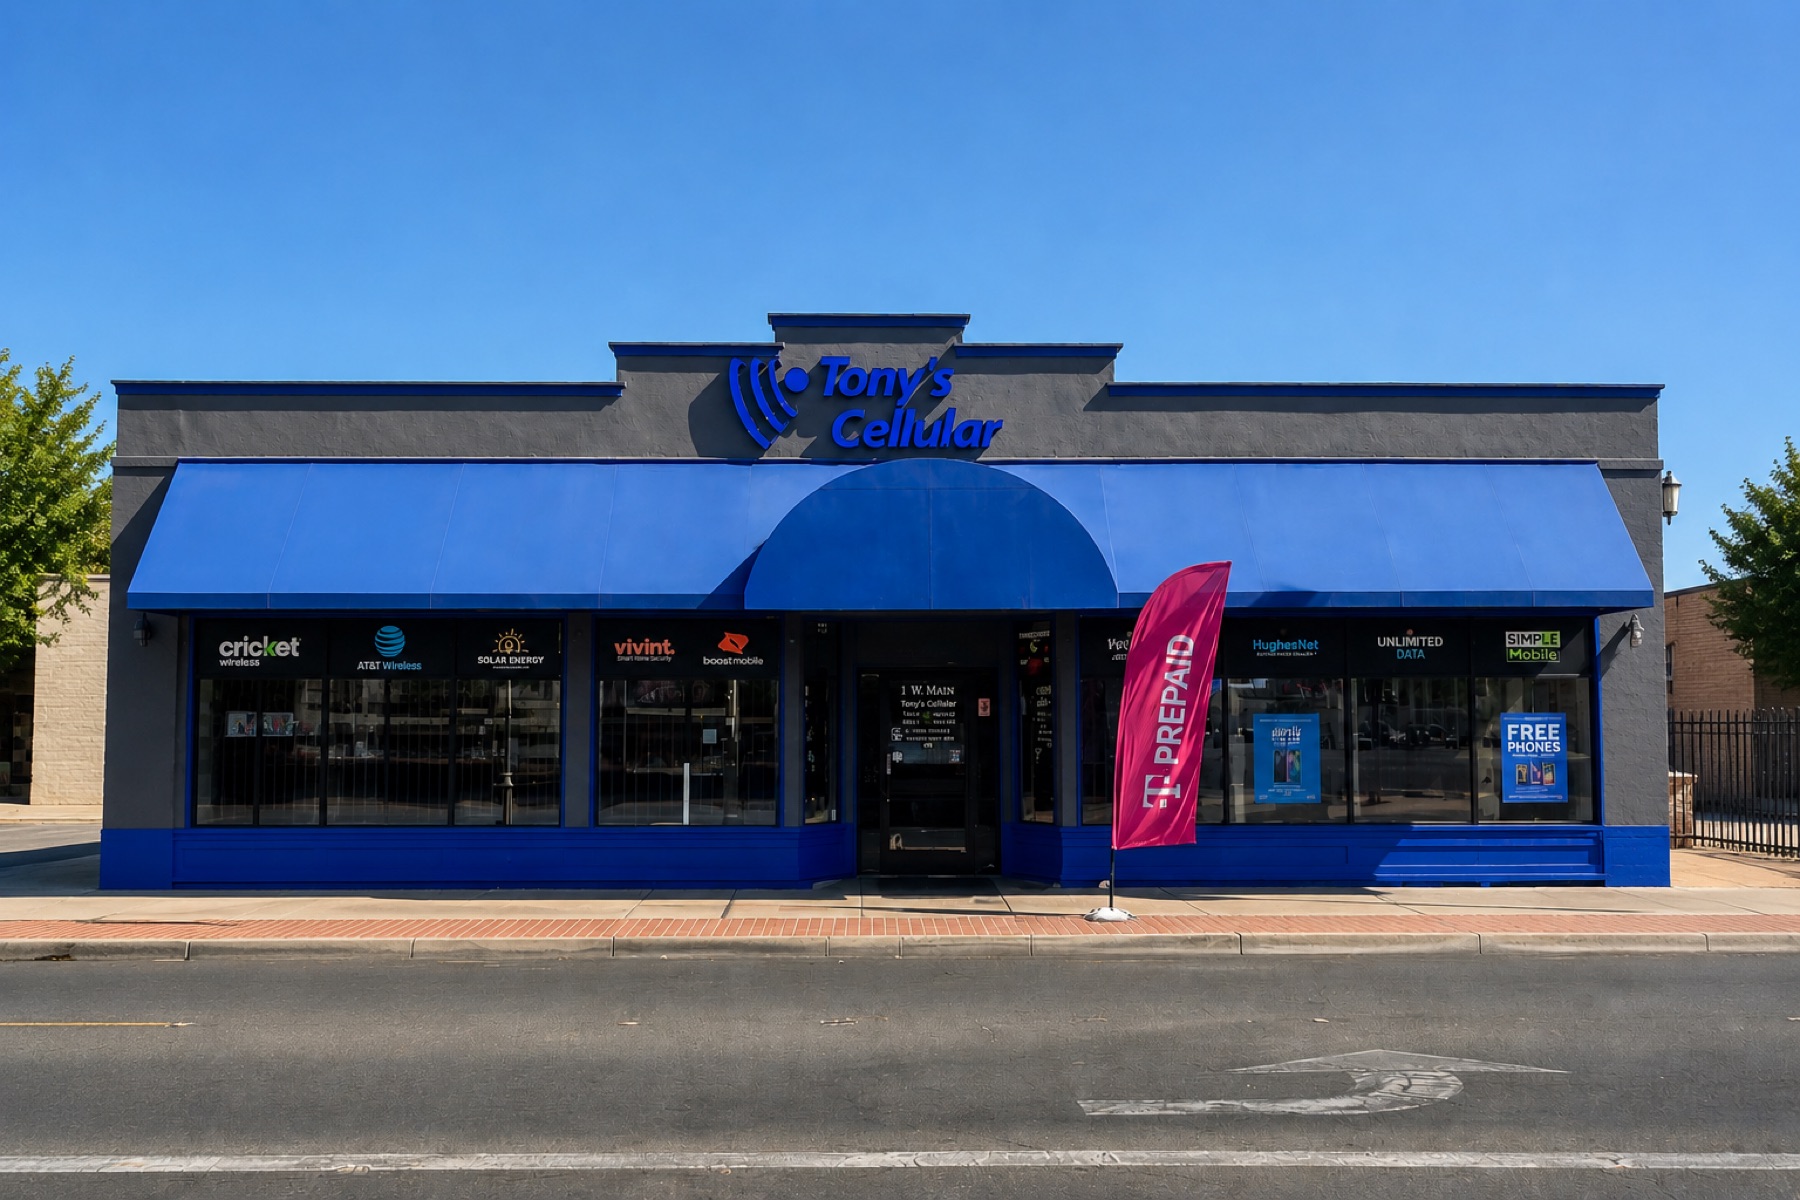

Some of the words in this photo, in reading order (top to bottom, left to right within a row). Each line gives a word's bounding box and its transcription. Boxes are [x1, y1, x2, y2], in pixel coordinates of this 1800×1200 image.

[820, 355, 955, 407] Tony's
[831, 407, 1004, 449] Cellular
[1377, 636, 1443, 647] UNLIMITED
[1507, 633, 1558, 645] SIMPLE
[218, 635, 300, 657] cricket
[1252, 639, 1319, 653] HughesNet
[1396, 649, 1425, 660] DATA
[1509, 648, 1557, 660] Mobile
[219, 658, 260, 667] wireless
[356, 661, 381, 670] AT&T
[382, 661, 422, 670] Wireless
[477, 656, 507, 664] SOLAR
[509, 656, 544, 664] ENERGY
[703, 656, 732, 665] boost
[733, 656, 763, 665] mobile
[901, 685, 906, 695] 1
[911, 685, 924, 695] W.
[901, 700, 925, 709] Tony's
[1153, 634, 1194, 765] PREPAID
[1507, 724, 1560, 740] FREE
[1507, 741, 1561, 752] PHONES
